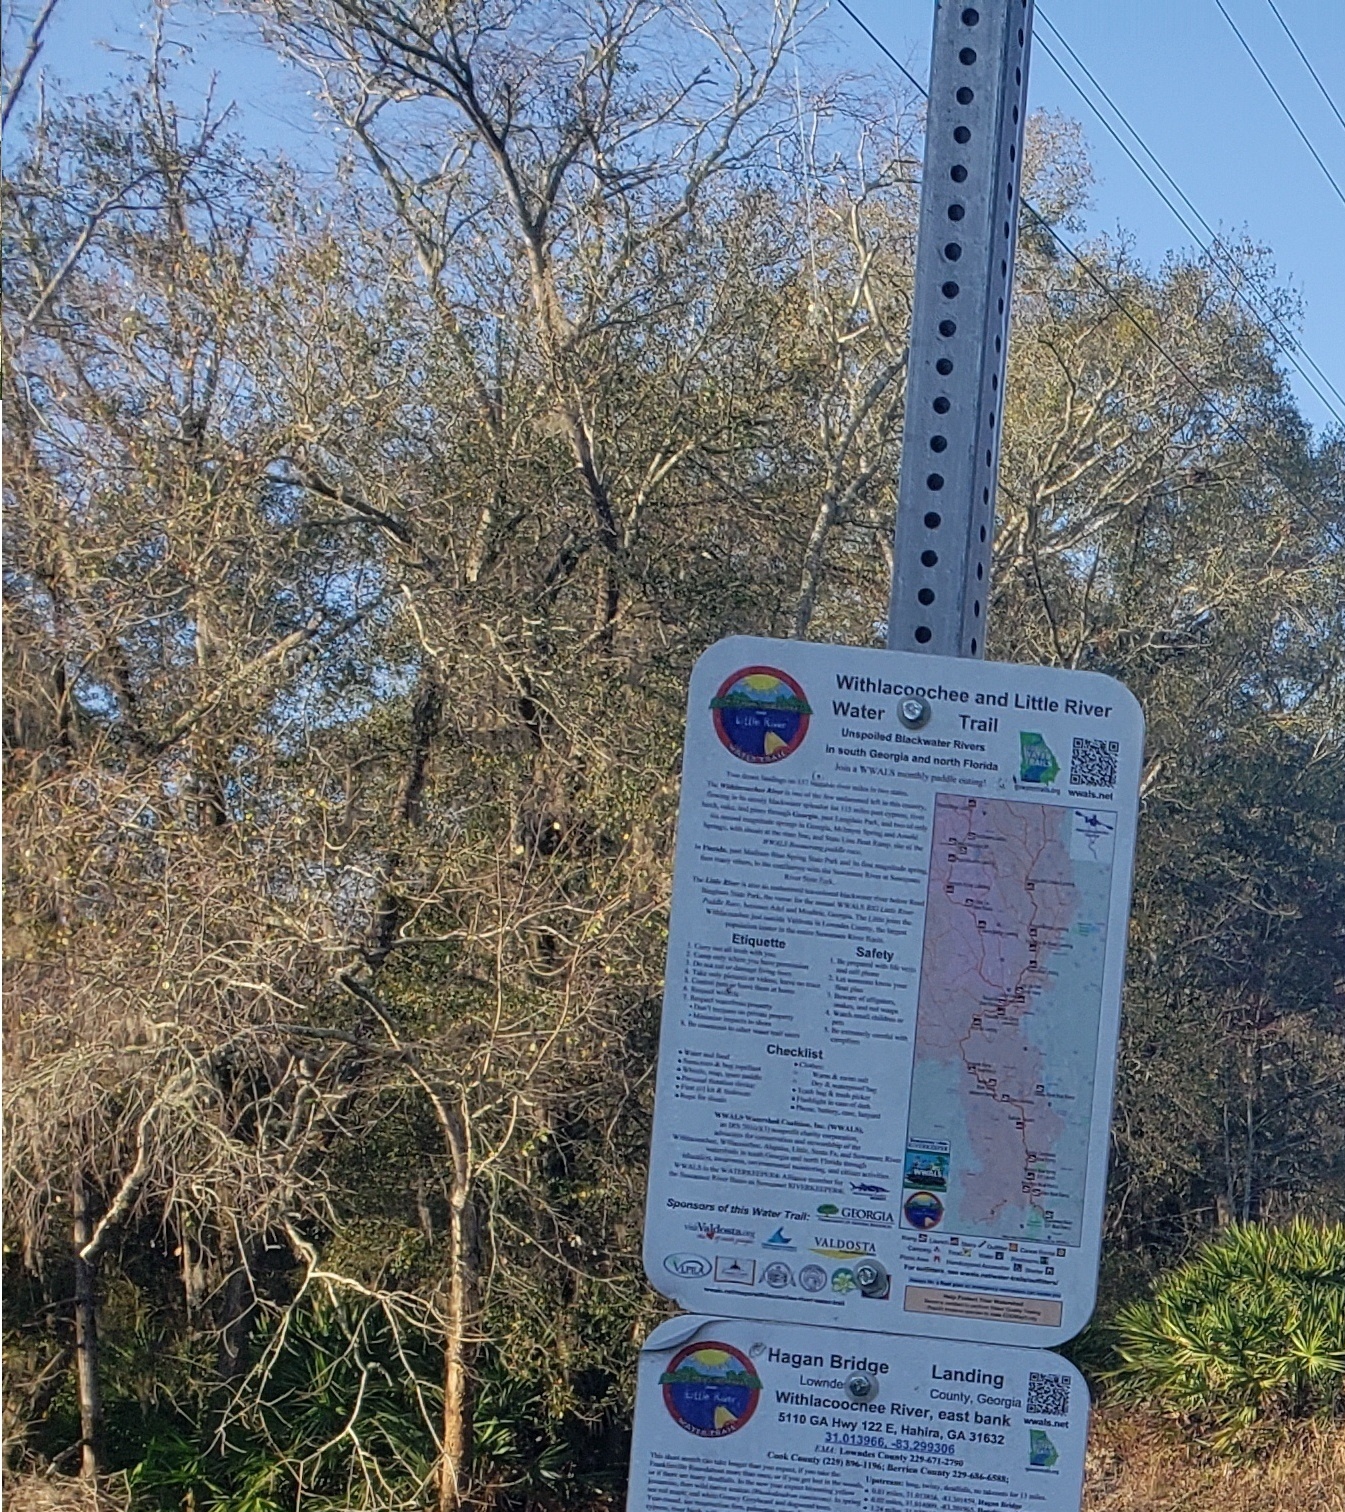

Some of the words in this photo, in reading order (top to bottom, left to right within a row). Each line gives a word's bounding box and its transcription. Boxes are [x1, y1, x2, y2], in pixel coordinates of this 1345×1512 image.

[835, 673, 969, 703] Withlacoochee
[975, 692, 1009, 707] and
[1014, 692, 1059, 712] Little
[1064, 698, 1113, 718] River
[832, 700, 886, 720] Water
[958, 713, 998, 733] Trail
[841, 727, 893, 742] Unspoiled
[894, 732, 951, 748] Blackwater
[952, 739, 986, 752] Rivers
[837, 747, 867, 757] south
[869, 748, 909, 763] Georgia
[911, 754, 931, 764] and
[932, 757, 961, 767] north
[962, 758, 998, 771] Florida
[731, 932, 786, 949] Etiquette
[855, 945, 894, 963] Safety
[766, 1043, 823, 1060] Checklist
[666, 1197, 715, 1211] Sponsors
[717, 1203, 729, 1213] of
[729, 1204, 749, 1215] this
[751, 1206, 782, 1218] Water
[784, 1209, 811, 1221] Trail:
[840, 1207, 894, 1223] GEORGIA
[813, 1236, 876, 1252] VALDOSTA
[767, 1347, 824, 1368] Hagan
[829, 1353, 889, 1376] Bridge
[931, 1364, 1004, 1390] Landing
[799, 1374, 844, 1389] Lownde
[929, 1388, 973, 1405] County,
[976, 1392, 1022, 1409] Georgia
[890, 1402, 933, 1421] River,
[937, 1410, 970, 1423] east
[973, 1410, 1011, 1427] bank
[777, 1411, 807, 1424] 5110
[809, 1414, 829, 1427] GA
[831, 1416, 858, 1432] Hwy
[861, 1420, 883, 1432] 122
[885, 1422, 897, 1436] E,
[900, 1423, 944, 1440] Hahira,
[946, 1429, 966, 1441] GA
[968, 1431, 1005, 1445] 31632
[824, 1431, 888, 1449] 31.013966,
[889, 1438, 955, 1456] -83.299306
[839, 1446, 876, 1458] Lowndes
[877, 1451, 908, 1463] County
